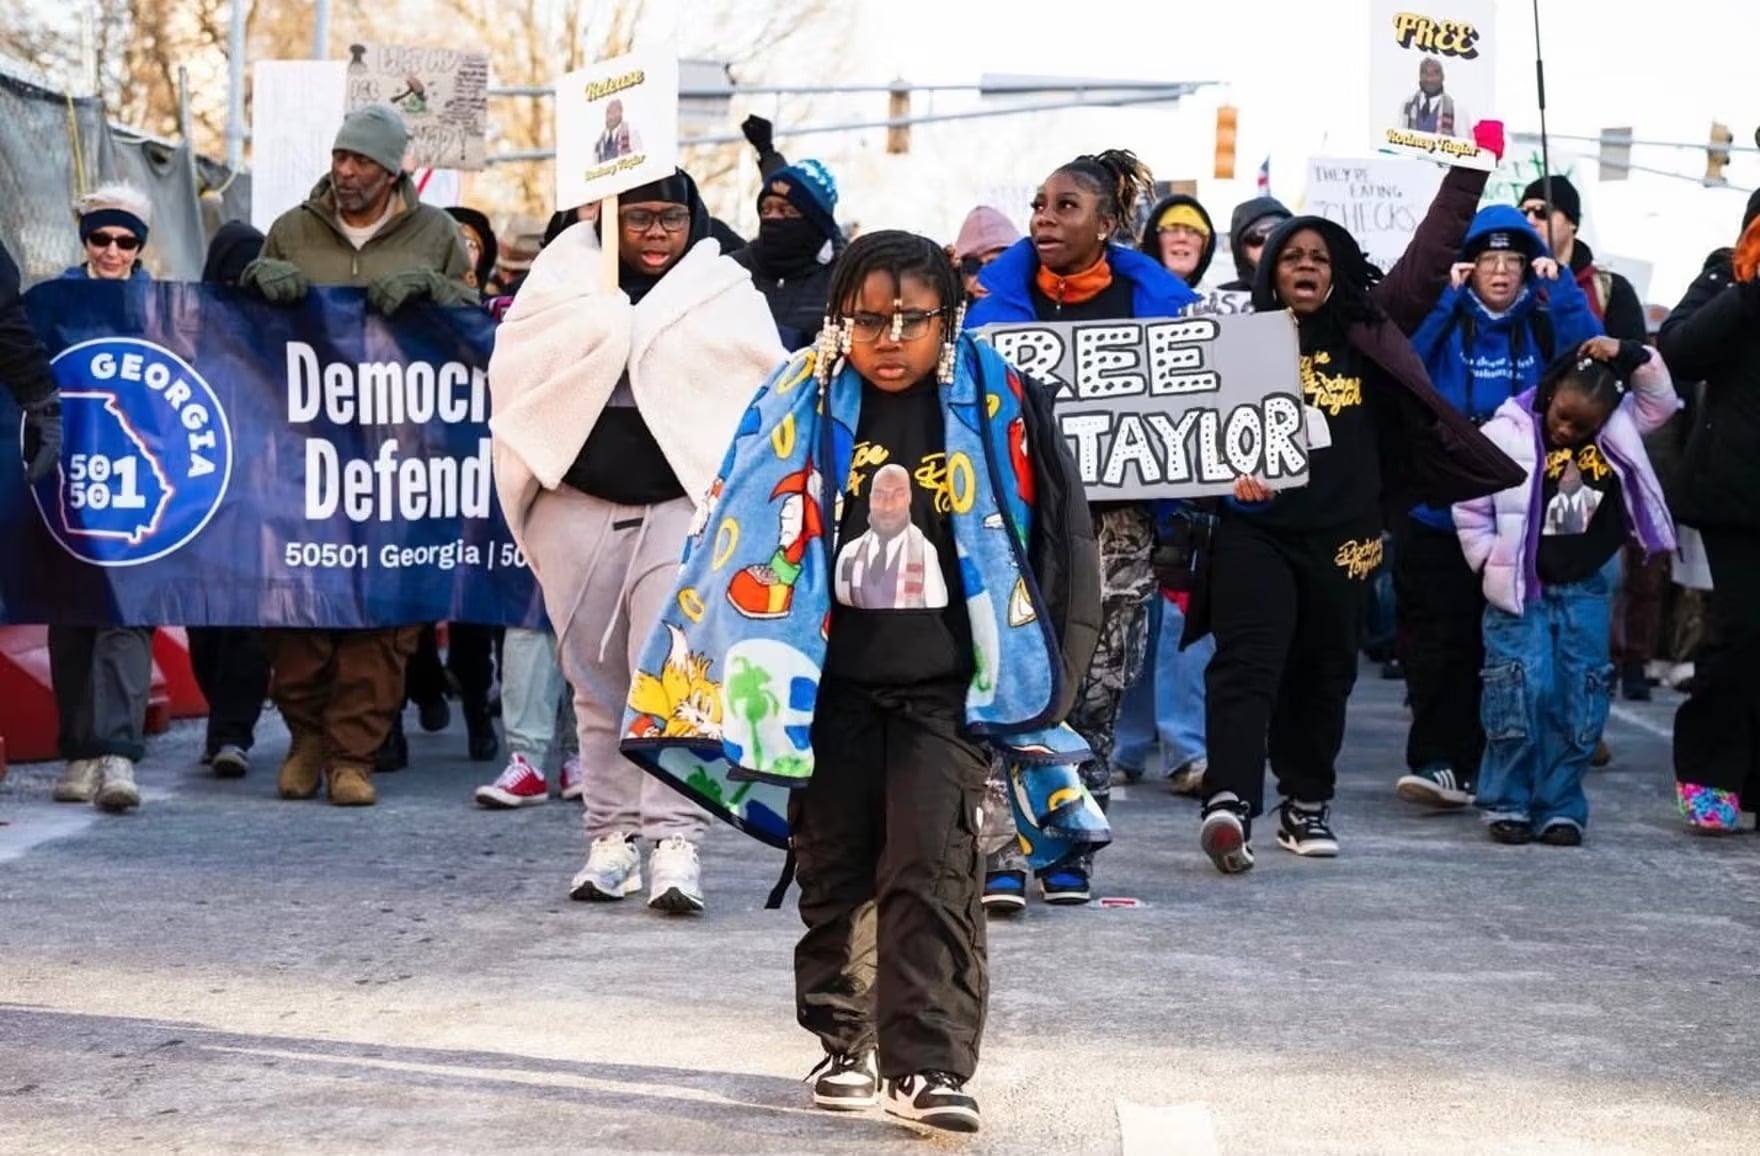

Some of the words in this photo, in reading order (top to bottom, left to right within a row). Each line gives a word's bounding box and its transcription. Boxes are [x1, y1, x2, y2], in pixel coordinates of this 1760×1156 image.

[1392, 11, 1480, 60] FREE
[584, 69, 646, 102] Release
[1386, 129, 1436, 154] Rodney
[1437, 138, 1481, 158] Taylor
[992, 319, 1220, 399] REE
[91, 352, 216, 479] GEORGIA
[1060, 392, 1307, 488] TAYLOR
[304, 437, 492, 522] Defend
[284, 542, 369, 569] 50501
[379, 539, 481, 570] Georgia
